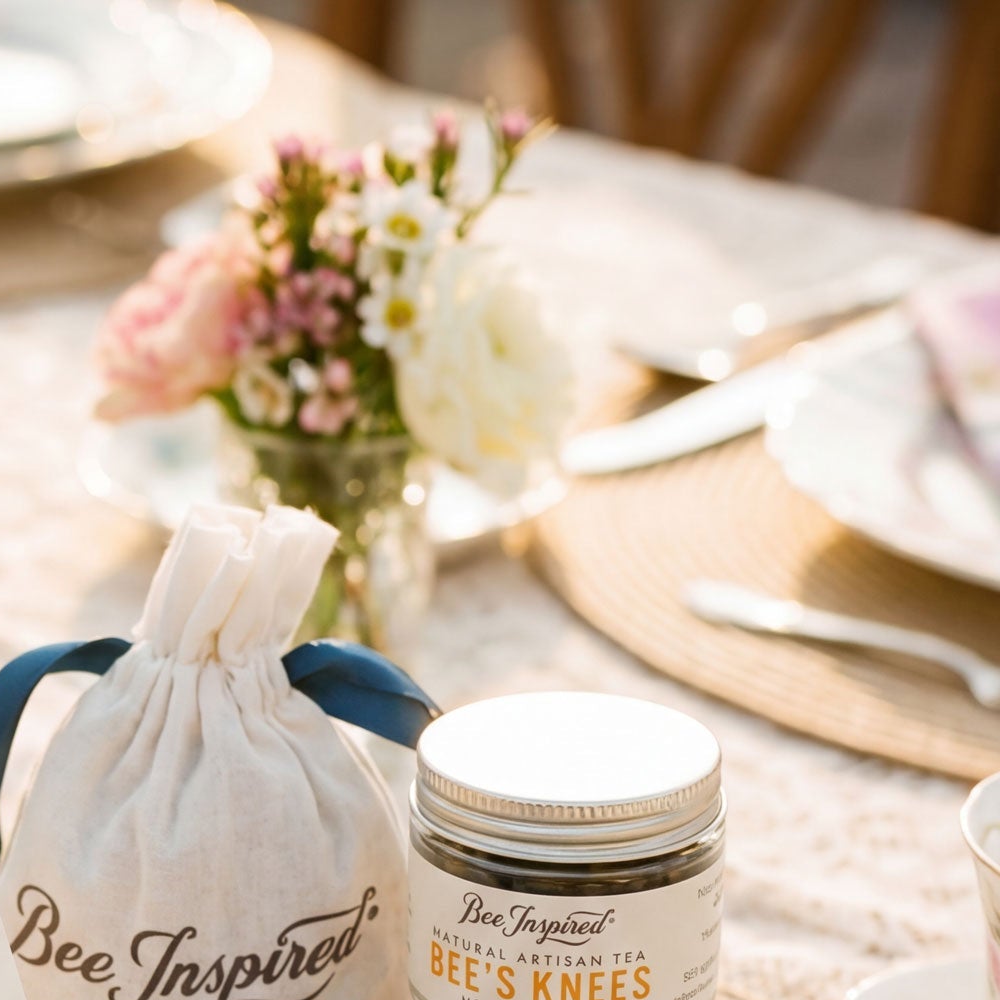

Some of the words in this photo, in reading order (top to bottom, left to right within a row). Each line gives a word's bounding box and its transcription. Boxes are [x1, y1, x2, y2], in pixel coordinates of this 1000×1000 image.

[457, 892, 506, 927] Bee
[11, 884, 115, 984] Bee
[430, 940, 516, 1000] BEE'S
[517, 952, 602, 967] ARTISAN
[613, 950, 646, 964] TEA
